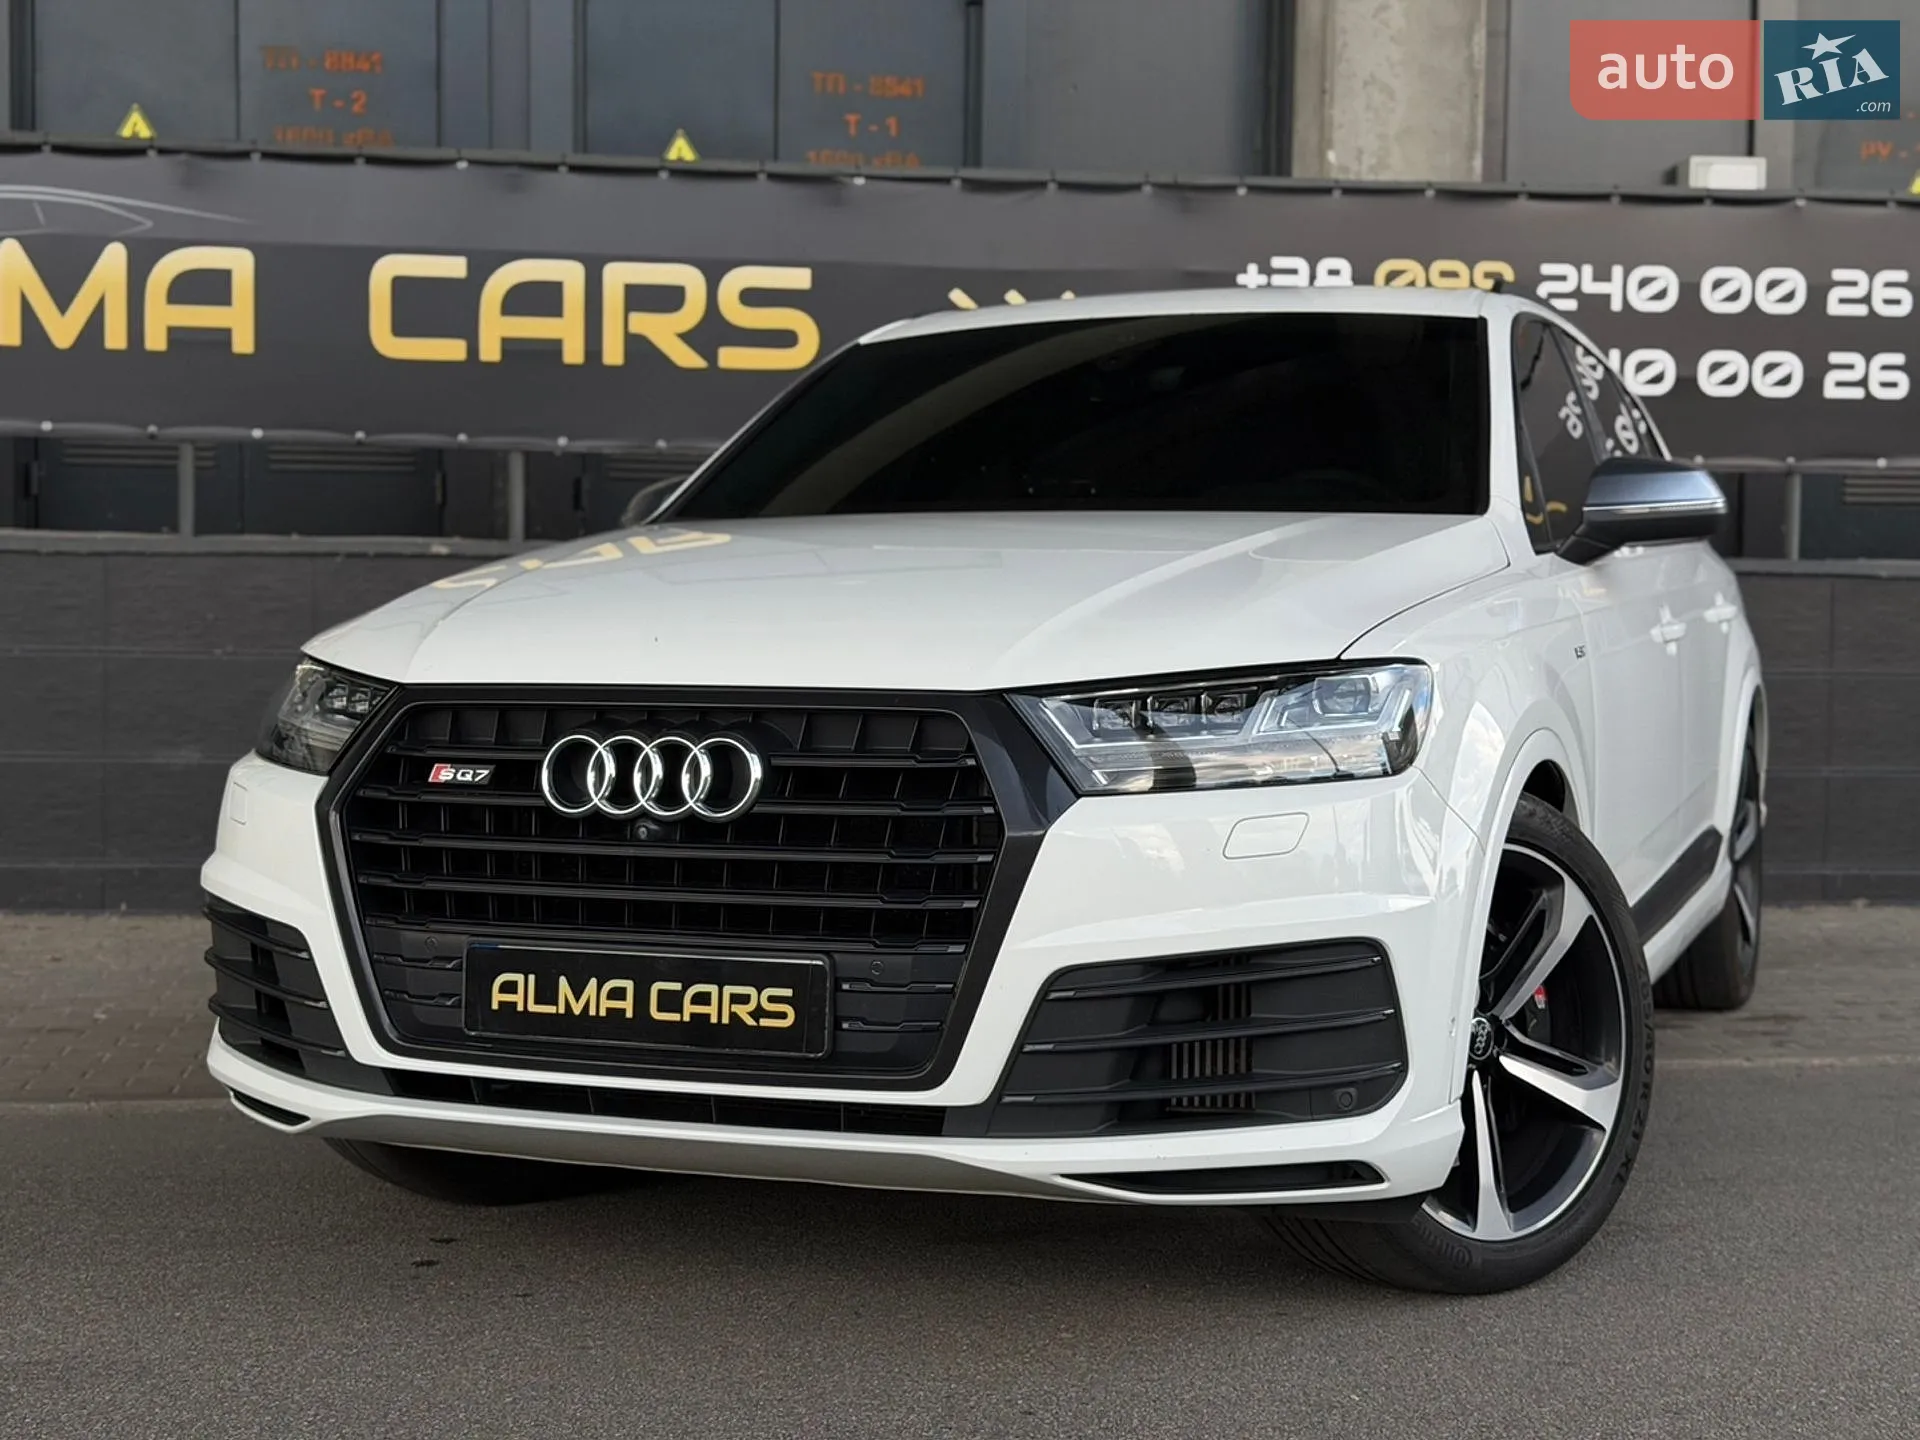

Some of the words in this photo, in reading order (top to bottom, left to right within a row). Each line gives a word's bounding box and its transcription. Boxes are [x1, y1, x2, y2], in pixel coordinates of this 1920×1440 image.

[369, 252, 820, 371] CARS
[1535, 263, 1680, 313] 240
[1699, 265, 1807, 315] 00
[1826, 268, 1913, 317] 26
[1696, 349, 1804, 398] 00
[1823, 351, 1910, 400] 26
[435, 763, 491, 783] SQ7
[490, 972, 635, 1019] ALMA
[649, 981, 796, 1028] CARS
